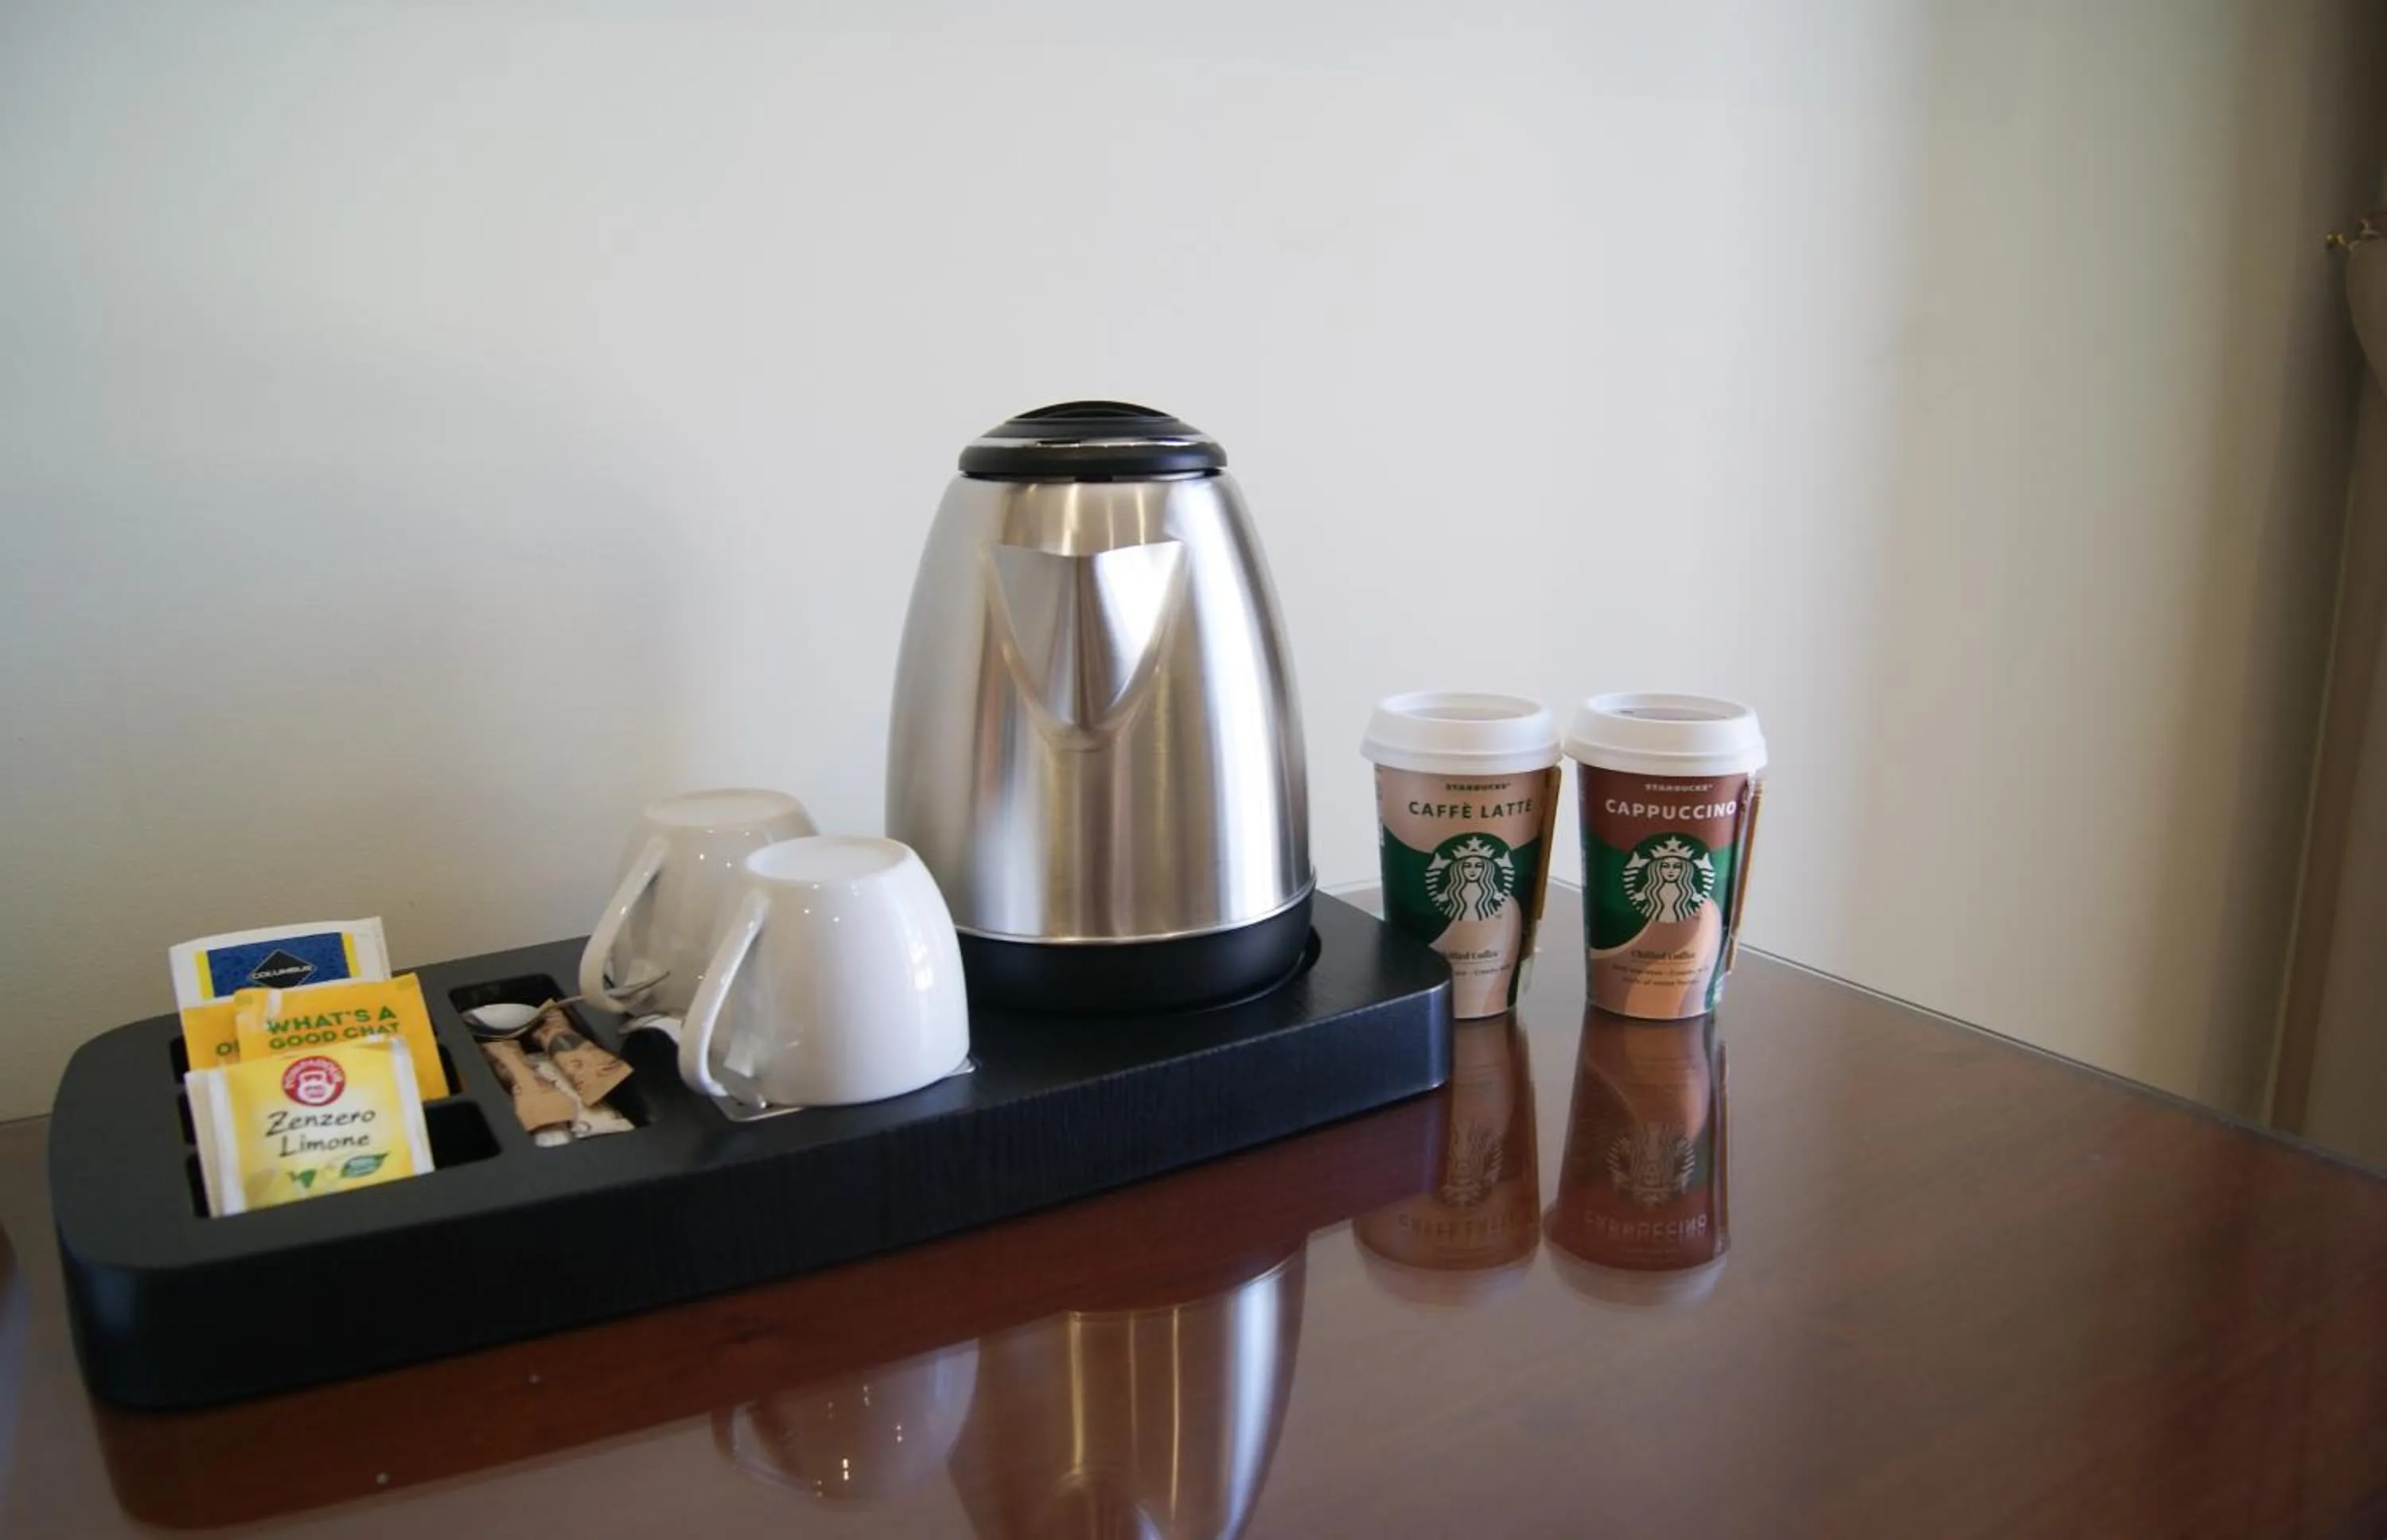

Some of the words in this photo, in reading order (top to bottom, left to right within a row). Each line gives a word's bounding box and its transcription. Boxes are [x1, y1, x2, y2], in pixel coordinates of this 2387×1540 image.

[1408, 801, 1472, 819] CAFFÈ
[1481, 799, 1532, 819] LATTE
[1605, 799, 1737, 820] CAPPUCCINO
[267, 1009, 370, 1034] WHAT'S
[378, 1005, 397, 1021] A
[269, 1029, 337, 1050] GOOD
[342, 1021, 400, 1039] CHAT
[265, 1110, 376, 1137] Zenzero
[278, 1134, 370, 1157] Limone
